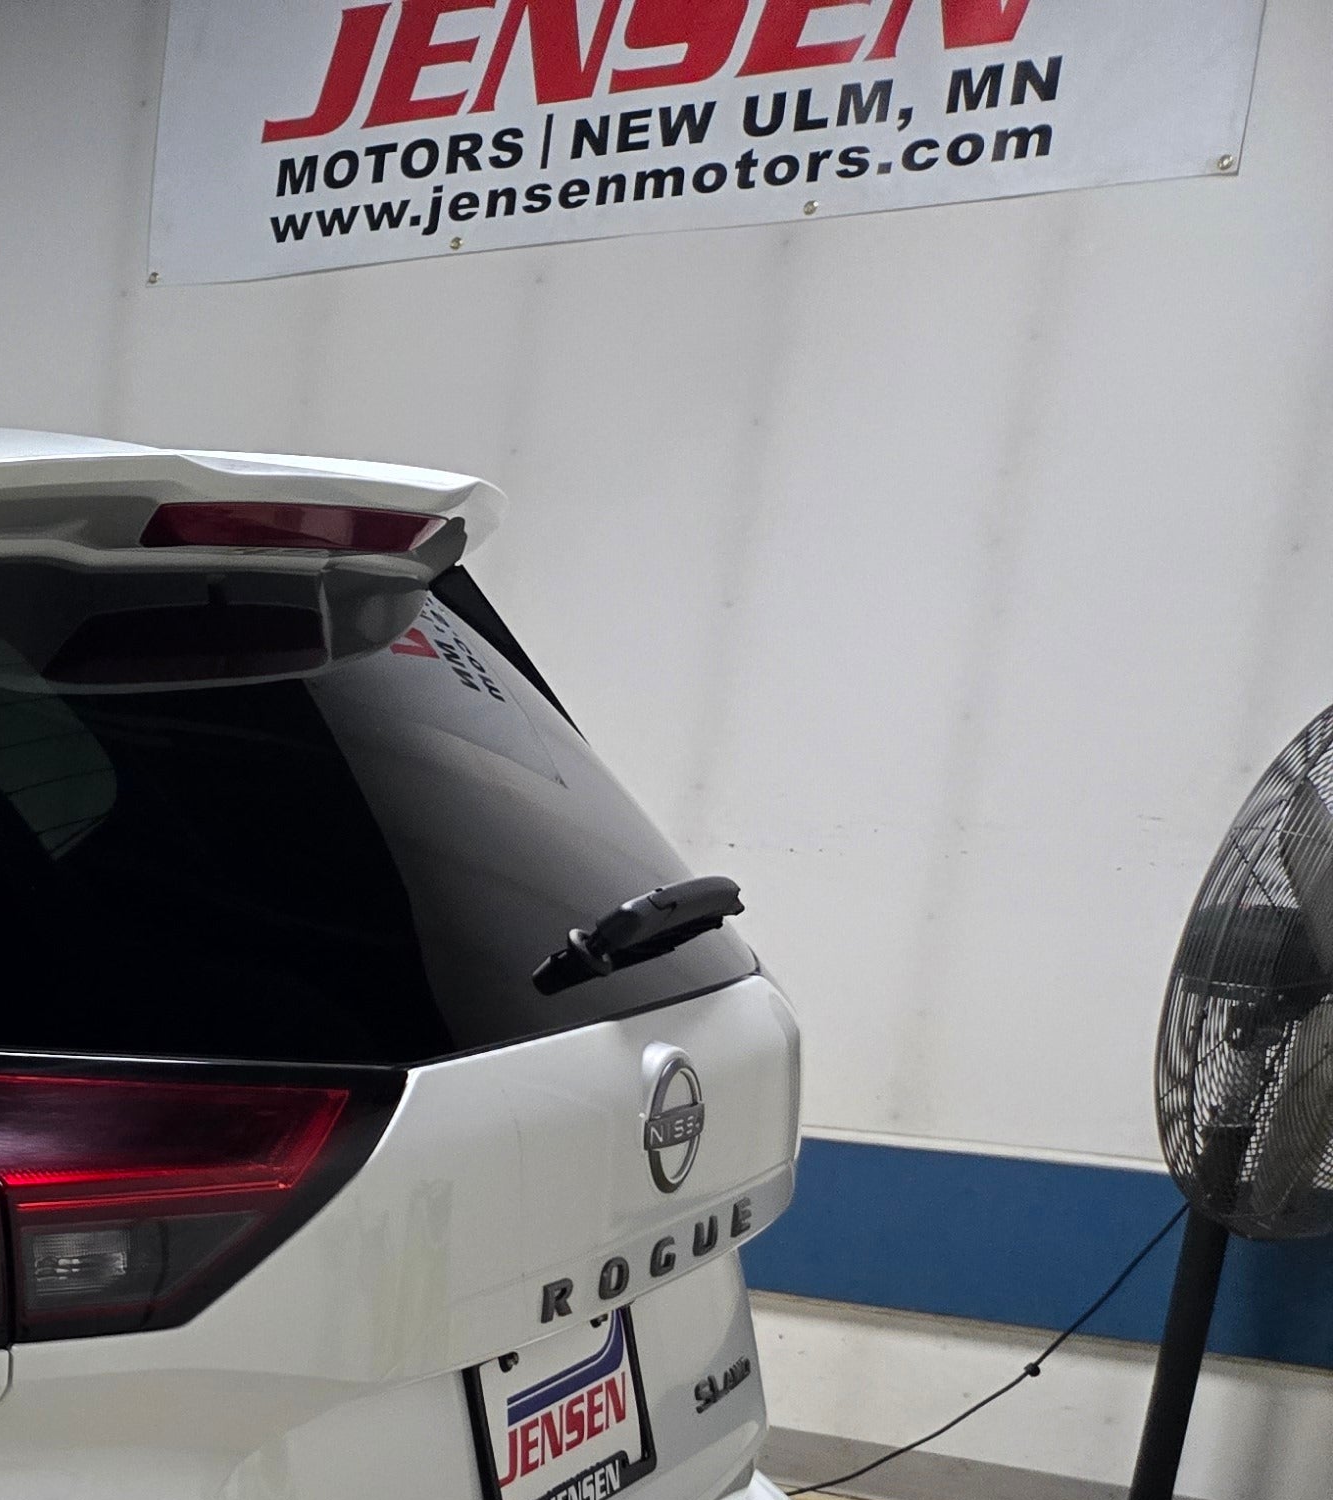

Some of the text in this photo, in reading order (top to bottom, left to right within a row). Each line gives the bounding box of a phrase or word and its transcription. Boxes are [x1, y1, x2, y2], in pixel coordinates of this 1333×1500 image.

[270, 123, 1053, 243] www.jensenmotors.com
[276, 56, 1063, 197] MOTORS NEW ULM, MN
[540, 1197, 752, 1324] ROGUE
[498, 1371, 626, 1488] JENSEN
